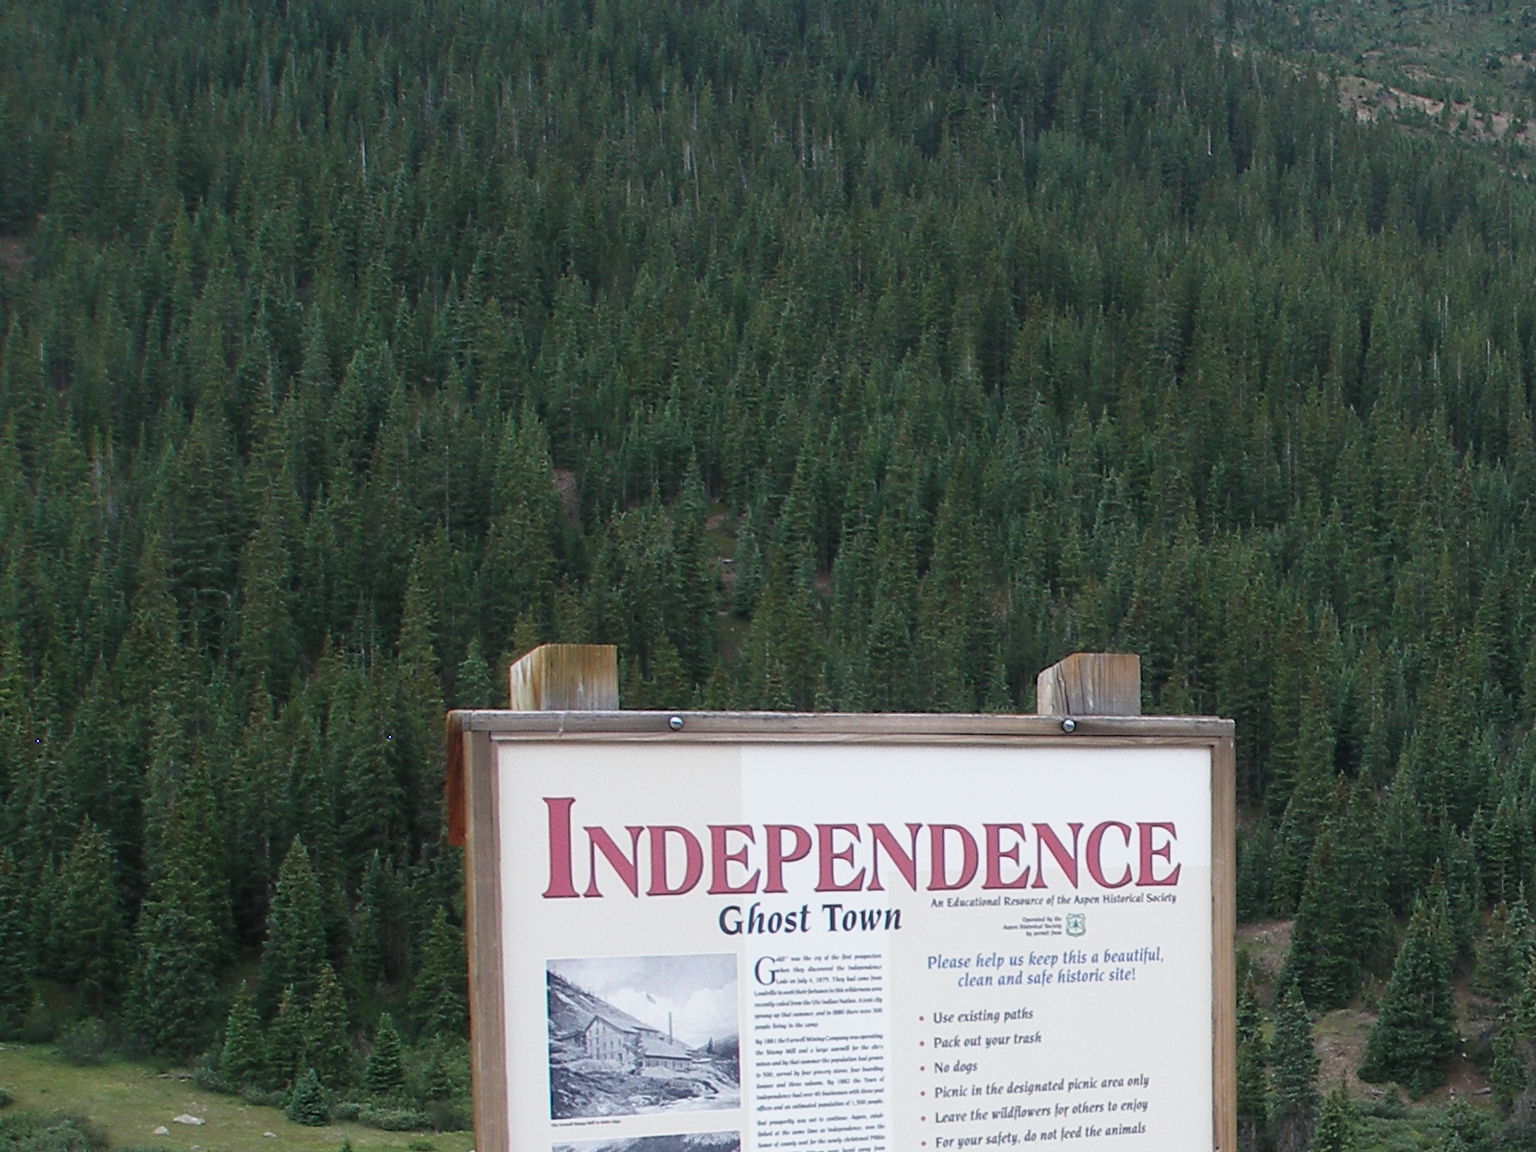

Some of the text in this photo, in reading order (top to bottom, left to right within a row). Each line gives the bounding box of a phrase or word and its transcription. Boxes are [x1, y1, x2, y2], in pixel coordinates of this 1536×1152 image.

[542, 797, 1181, 898] INDEPENDENCE
[930, 893, 1177, 908] An Educational Resource of the Aspen Historical Society
[719, 902, 903, 935] Ghost Town
[928, 948, 1164, 969] Please help us keep this a beautiful,
[958, 967, 1136, 987] clean and safe historic site!
[933, 1008, 1034, 1024] Use existing paths
[934, 1032, 1042, 1048] Pack out your trash
[934, 1061, 978, 1075] No dogs
[934, 1074, 1150, 1098] Picnic in the designated picnic area only
[935, 1100, 1148, 1124] Leave the wildflowers for others to enjoy
[936, 1123, 1146, 1150] For your safety, do not feed the animals
